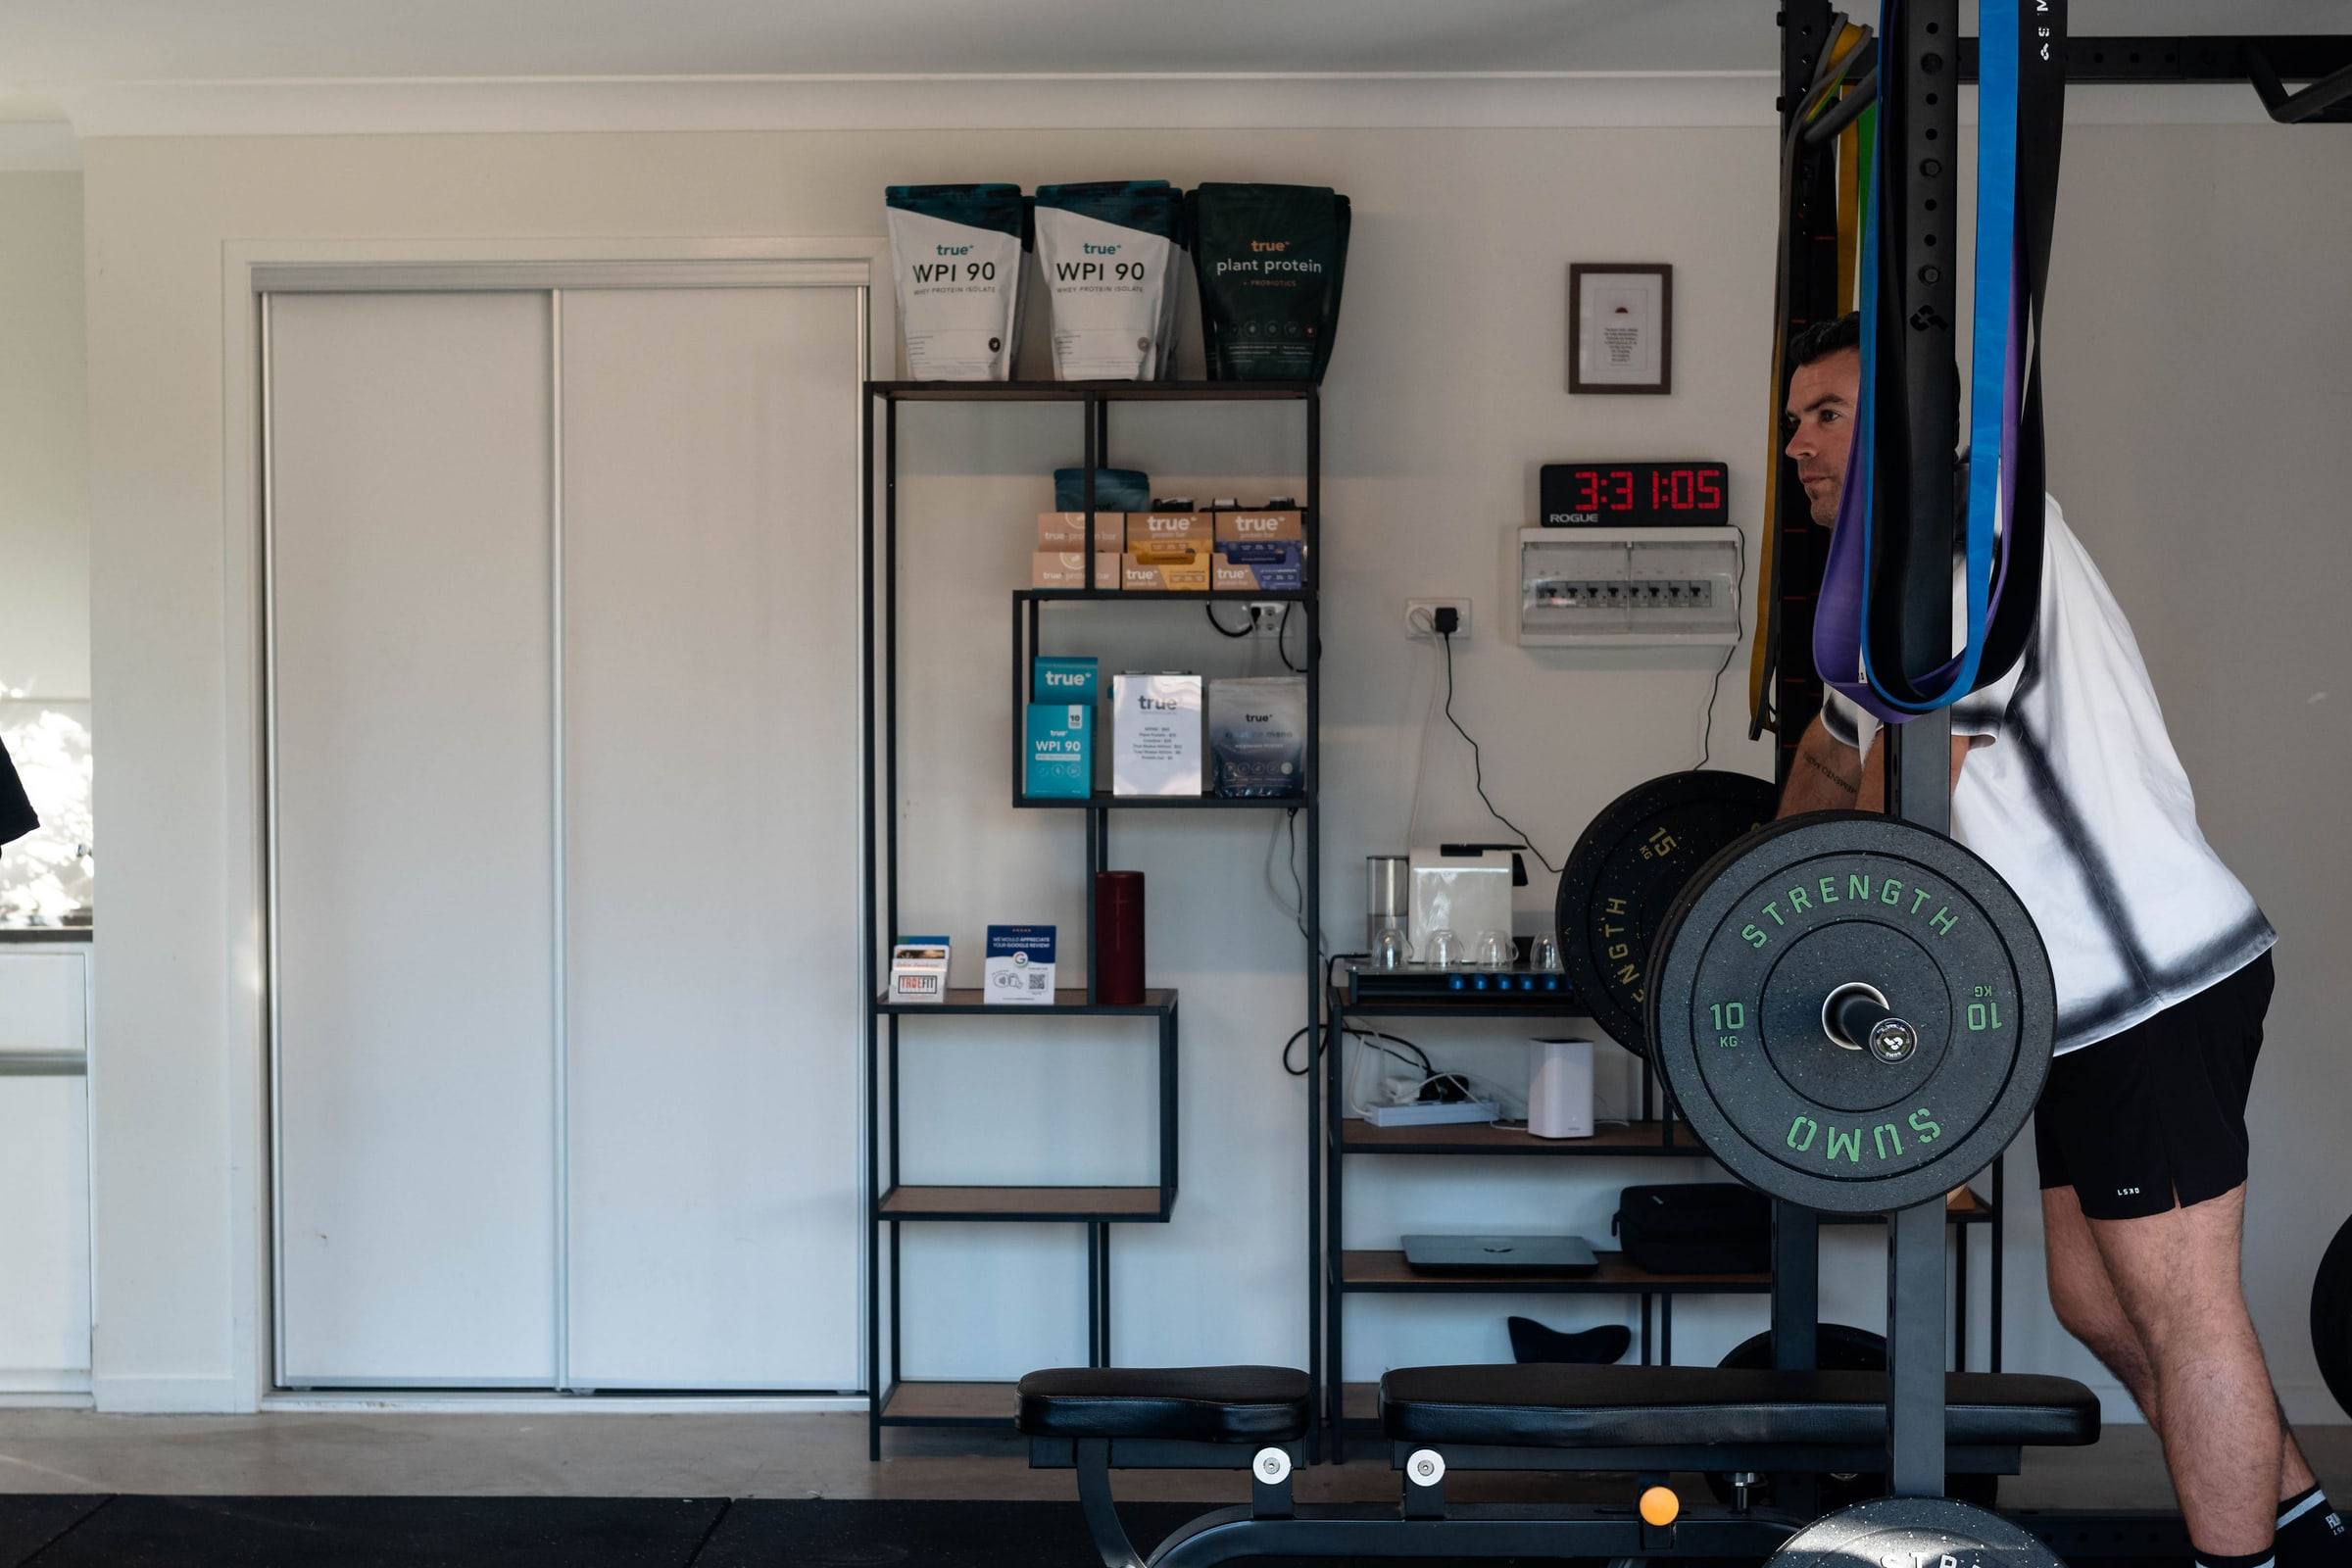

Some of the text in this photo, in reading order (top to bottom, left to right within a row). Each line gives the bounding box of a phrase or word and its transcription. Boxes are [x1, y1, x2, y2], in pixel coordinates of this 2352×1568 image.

[936, 245, 969, 255] true
[1083, 243, 1116, 255] true
[1250, 240, 1285, 252] true
[912, 262, 996, 284] WPI 90
[1056, 262, 1145, 281] WPI 90
[1216, 258, 1322, 276] plant protein
[1147, 515, 1191, 531] true
[1236, 515, 1279, 531] true
[1549, 513, 1598, 523] ROGUE
[1043, 571, 1062, 580] true
[1126, 569, 1153, 580] true
[1216, 567, 1245, 580] true
[1046, 670, 1085, 686] true
[1138, 695, 1177, 710] true
[1069, 714, 1080, 723] 10
[1245, 713, 1269, 722] true
[1035, 740, 1081, 752] WPI 90
[1648, 826, 1678, 857] 15
[1639, 845, 1653, 860] KG
[1740, 874, 1959, 949] STRENGTH
[1974, 985, 1992, 998] KG
[1710, 1002, 1745, 1031] 10
[1967, 1003, 2002, 1032] 10
[1720, 1035, 1739, 1048] KG
[1786, 1107, 1941, 1163] SUMO
